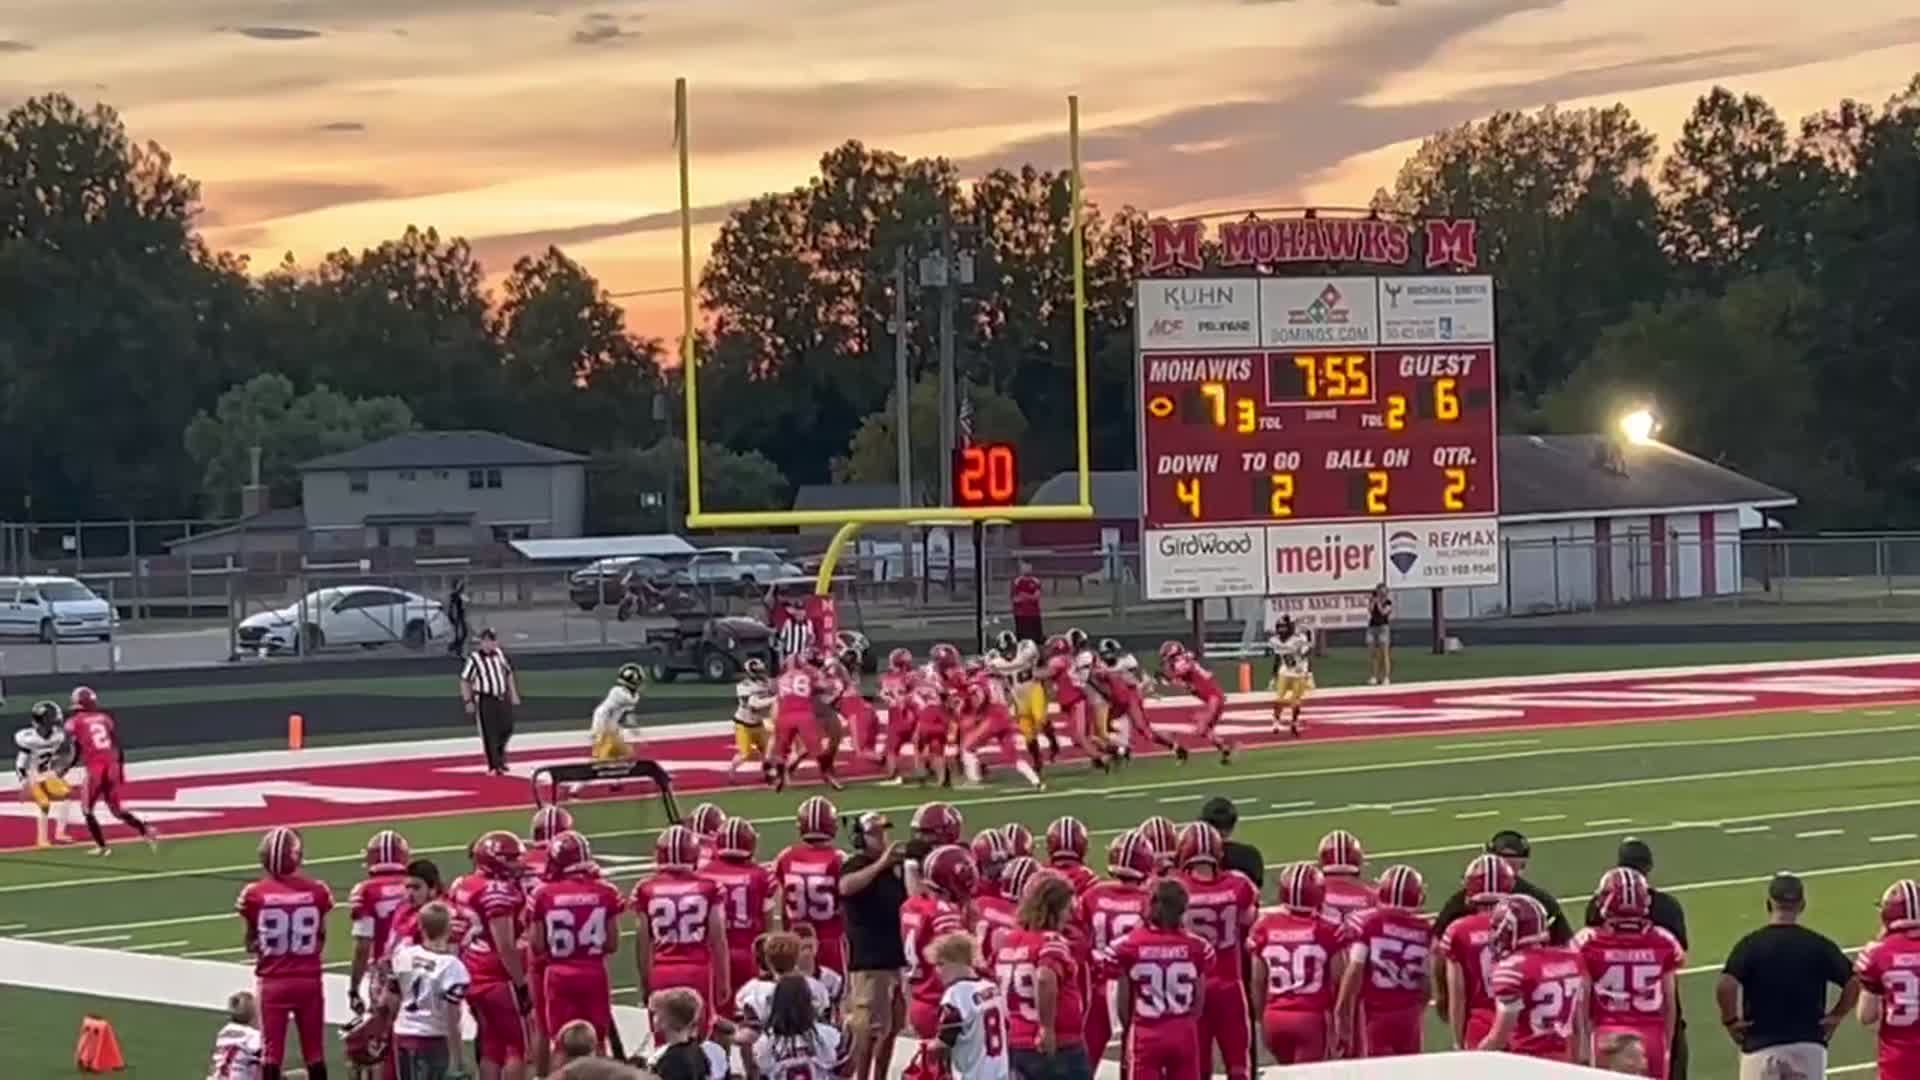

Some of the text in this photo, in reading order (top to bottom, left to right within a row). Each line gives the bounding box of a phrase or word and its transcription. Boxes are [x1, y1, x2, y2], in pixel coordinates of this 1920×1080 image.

[1150, 218, 1477, 270] M MOHAWKS M
[1164, 286, 1233, 305] KUHN
[1150, 358, 1252, 382] MOHAWKS
[1294, 356, 1369, 398] 7:55
[1399, 354, 1476, 377] GUEST
[1200, 383, 1226, 426] 7
[1237, 398, 1257, 434] 3
[1388, 396, 1406, 430] 2
[1434, 379, 1460, 420] 6
[961, 446, 1014, 501] 20
[1157, 454, 1219, 474] DOWN
[1241, 452, 1300, 472] TO GO
[1325, 448, 1410, 470] BALL ON
[1433, 447, 1477, 466] QTR.
[1176, 478, 1201, 518] 4
[1270, 474, 1294, 516] 2
[1366, 472, 1388, 513] 2
[1443, 469, 1466, 510] 2
[1276, 535, 1375, 579] meijer
[1428, 529, 1496, 548] RE/MAX
[783, 872, 836, 921] 35
[546, 906, 607, 958] 64
[648, 895, 709, 944] 22
[1129, 961, 1199, 1019] 36
[1261, 944, 1328, 995] 60
[1594, 965, 1664, 1012] 45
[1529, 976, 1585, 1039] 27
